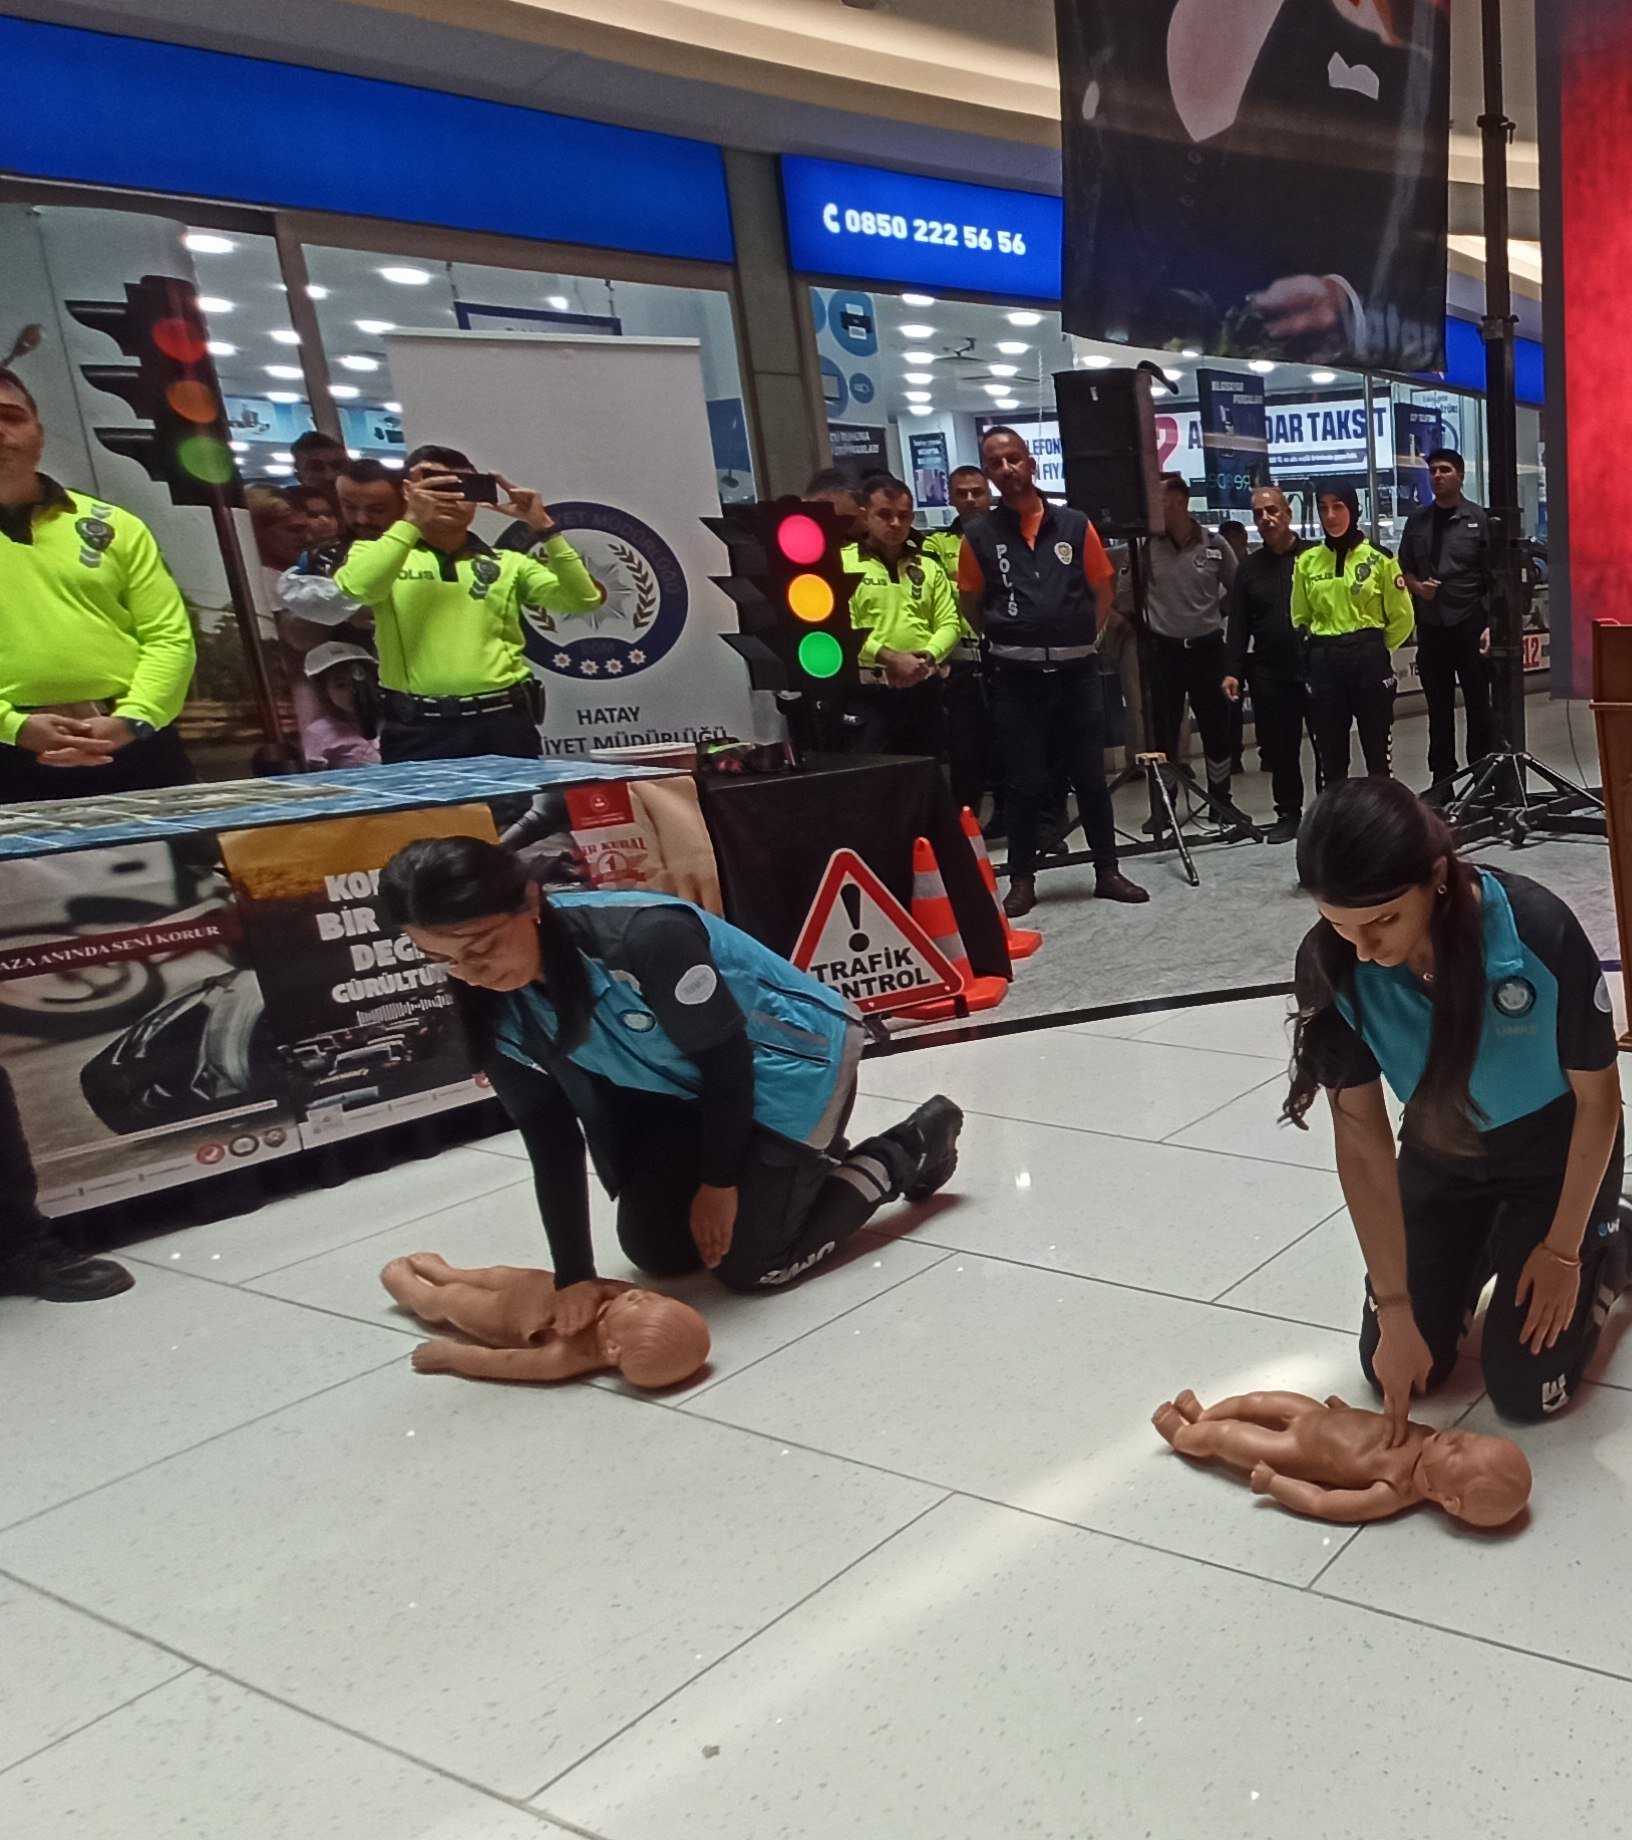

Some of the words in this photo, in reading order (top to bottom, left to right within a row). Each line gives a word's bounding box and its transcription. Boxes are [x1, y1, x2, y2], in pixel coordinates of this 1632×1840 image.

[845, 208, 908, 239] 0850
[912, 219, 959, 247] 222
[963, 225, 993, 251] 56
[997, 230, 1027, 256] 56
[1306, 407, 1387, 442] TAKST
[577, 705, 641, 727] HATAY
[315, 905, 381, 941] BİR
[38, 944, 111, 963] ANINDA
[112, 933, 154, 951] SENİ
[154, 925, 220, 946] KORUR
[810, 946, 914, 983] TRAFİK
